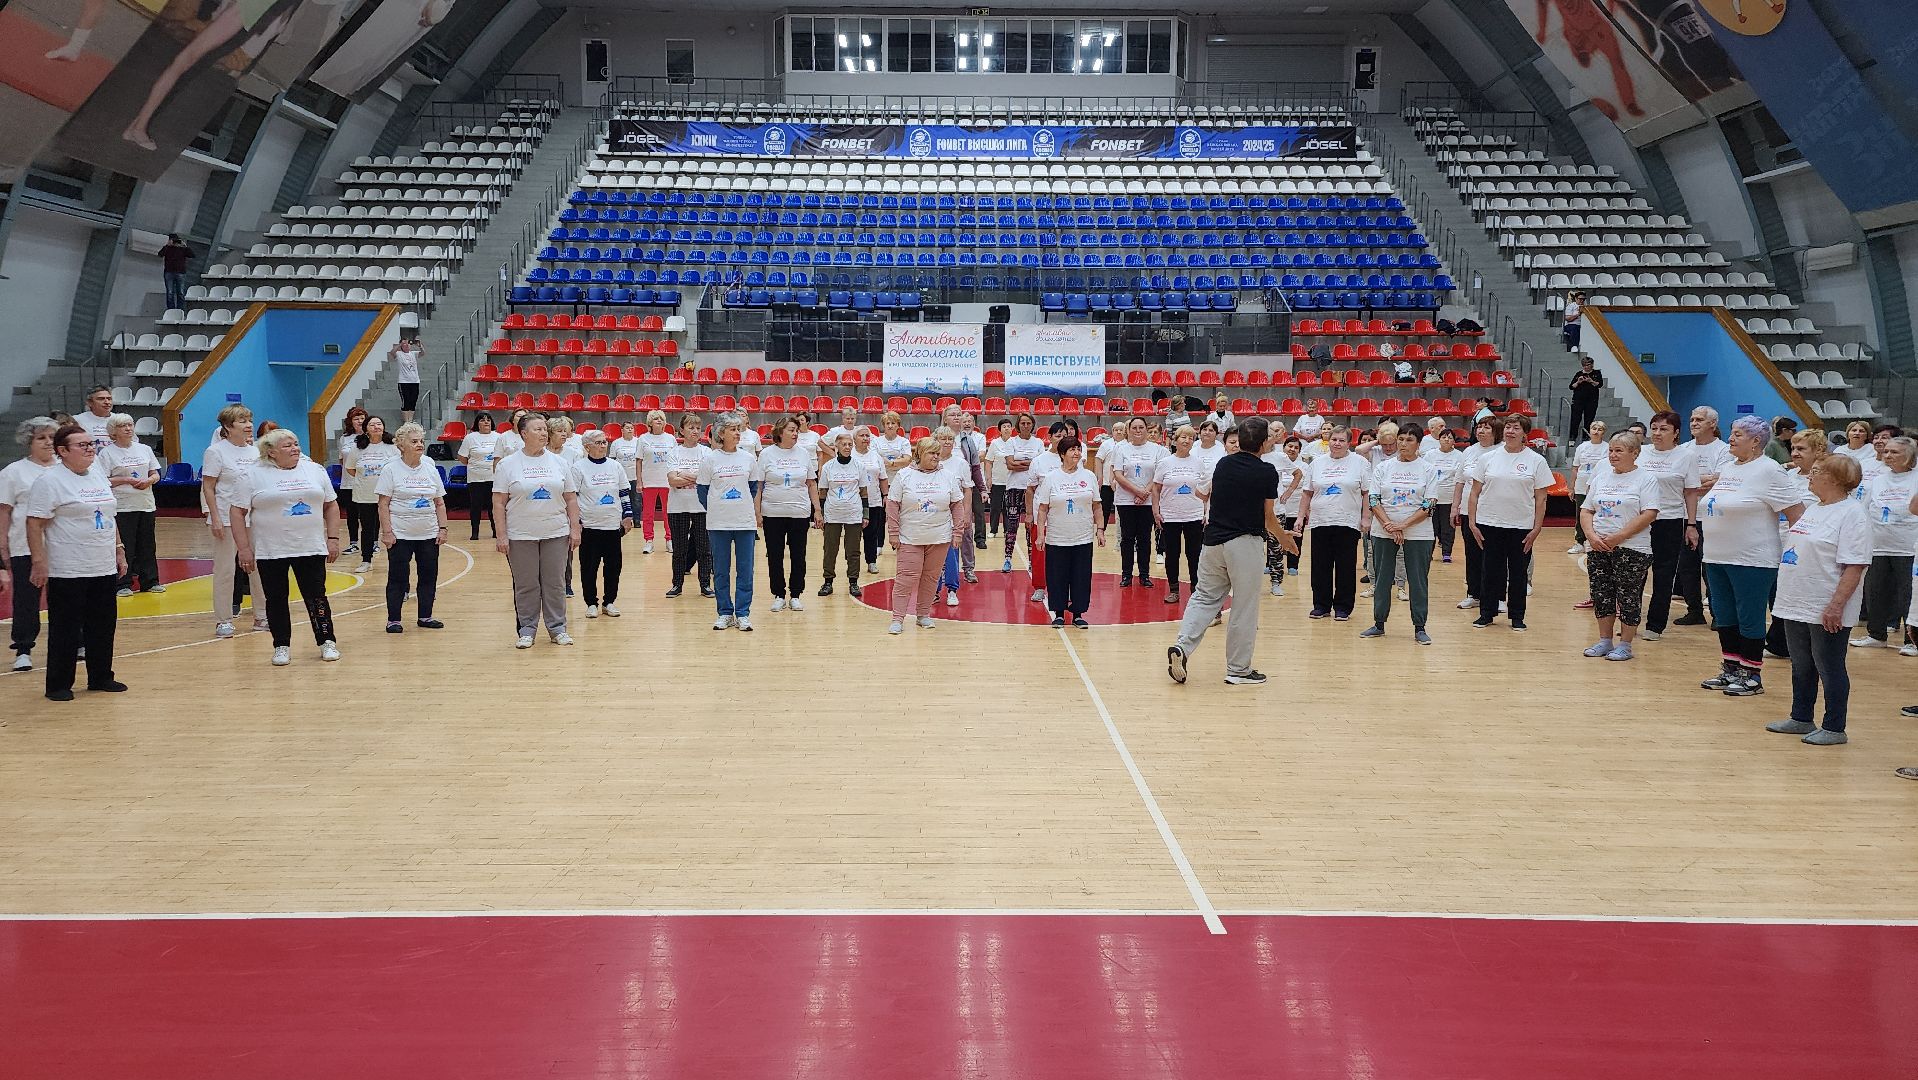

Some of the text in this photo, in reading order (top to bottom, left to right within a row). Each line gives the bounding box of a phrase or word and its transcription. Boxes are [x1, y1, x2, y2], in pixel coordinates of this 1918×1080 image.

[617, 131, 666, 144] JÖGEL
[820, 138, 875, 150] FONBET
[936, 138, 967, 151] FONBET
[967, 138, 1004, 151] ВЫСШАЯ
[1005, 138, 1028, 151] ЛИГА
[1090, 139, 1145, 151] FONBET
[1299, 138, 1348, 150] JÖGEL
[889, 329, 976, 346] Активное
[889, 343, 978, 359] долголетие
[1009, 355, 1101, 366] ПРИВЕТСТВУЕМ
